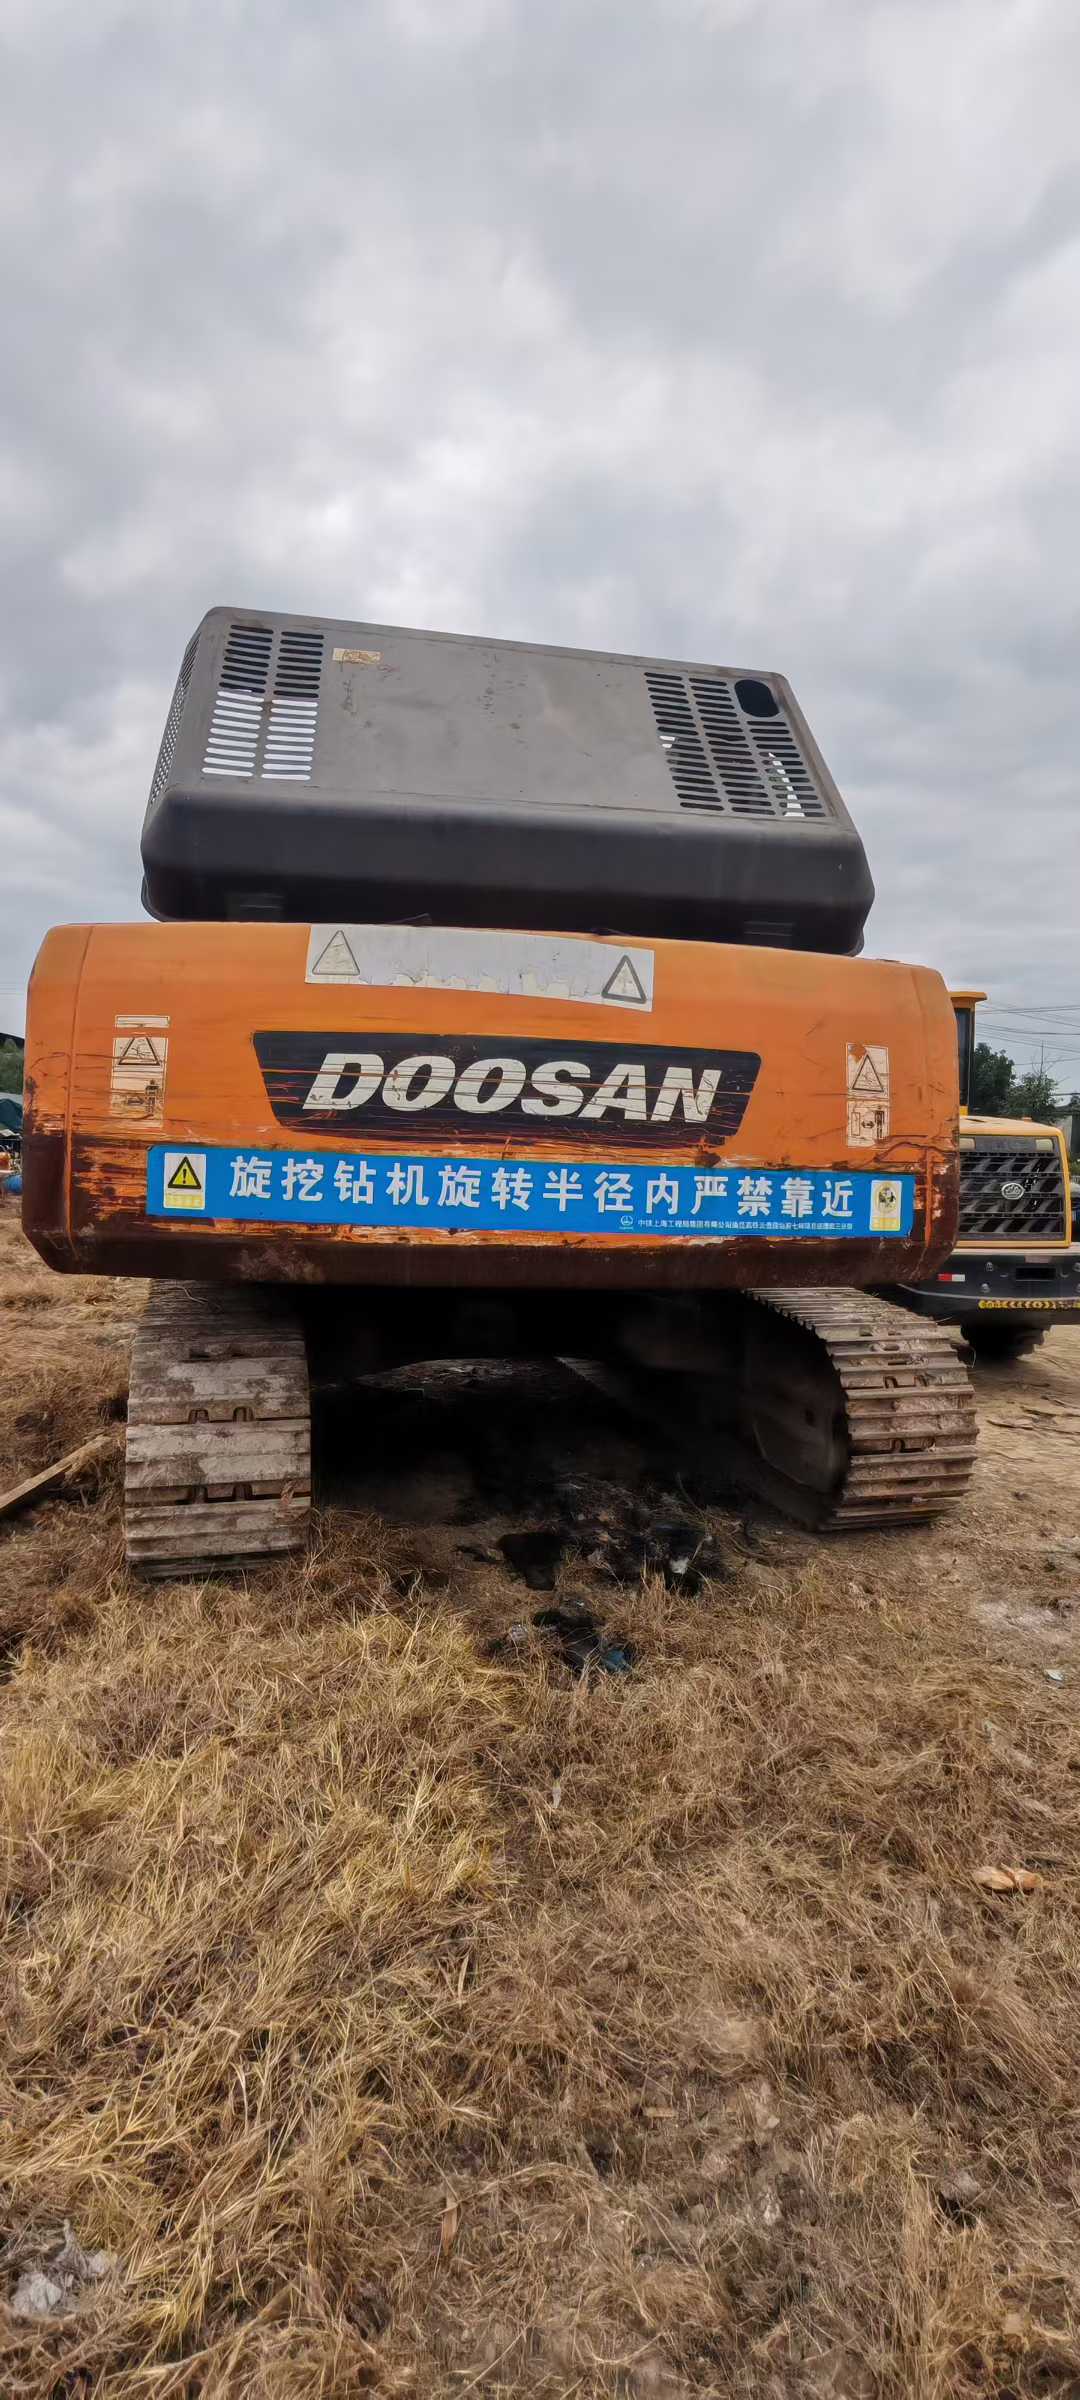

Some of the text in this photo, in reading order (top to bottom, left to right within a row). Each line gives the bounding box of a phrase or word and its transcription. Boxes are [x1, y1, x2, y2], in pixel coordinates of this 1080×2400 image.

[302, 1053, 722, 1123] DOOSAN
[229, 1155, 853, 1218] 旋挖钻机旋转半径内严禁靠近
